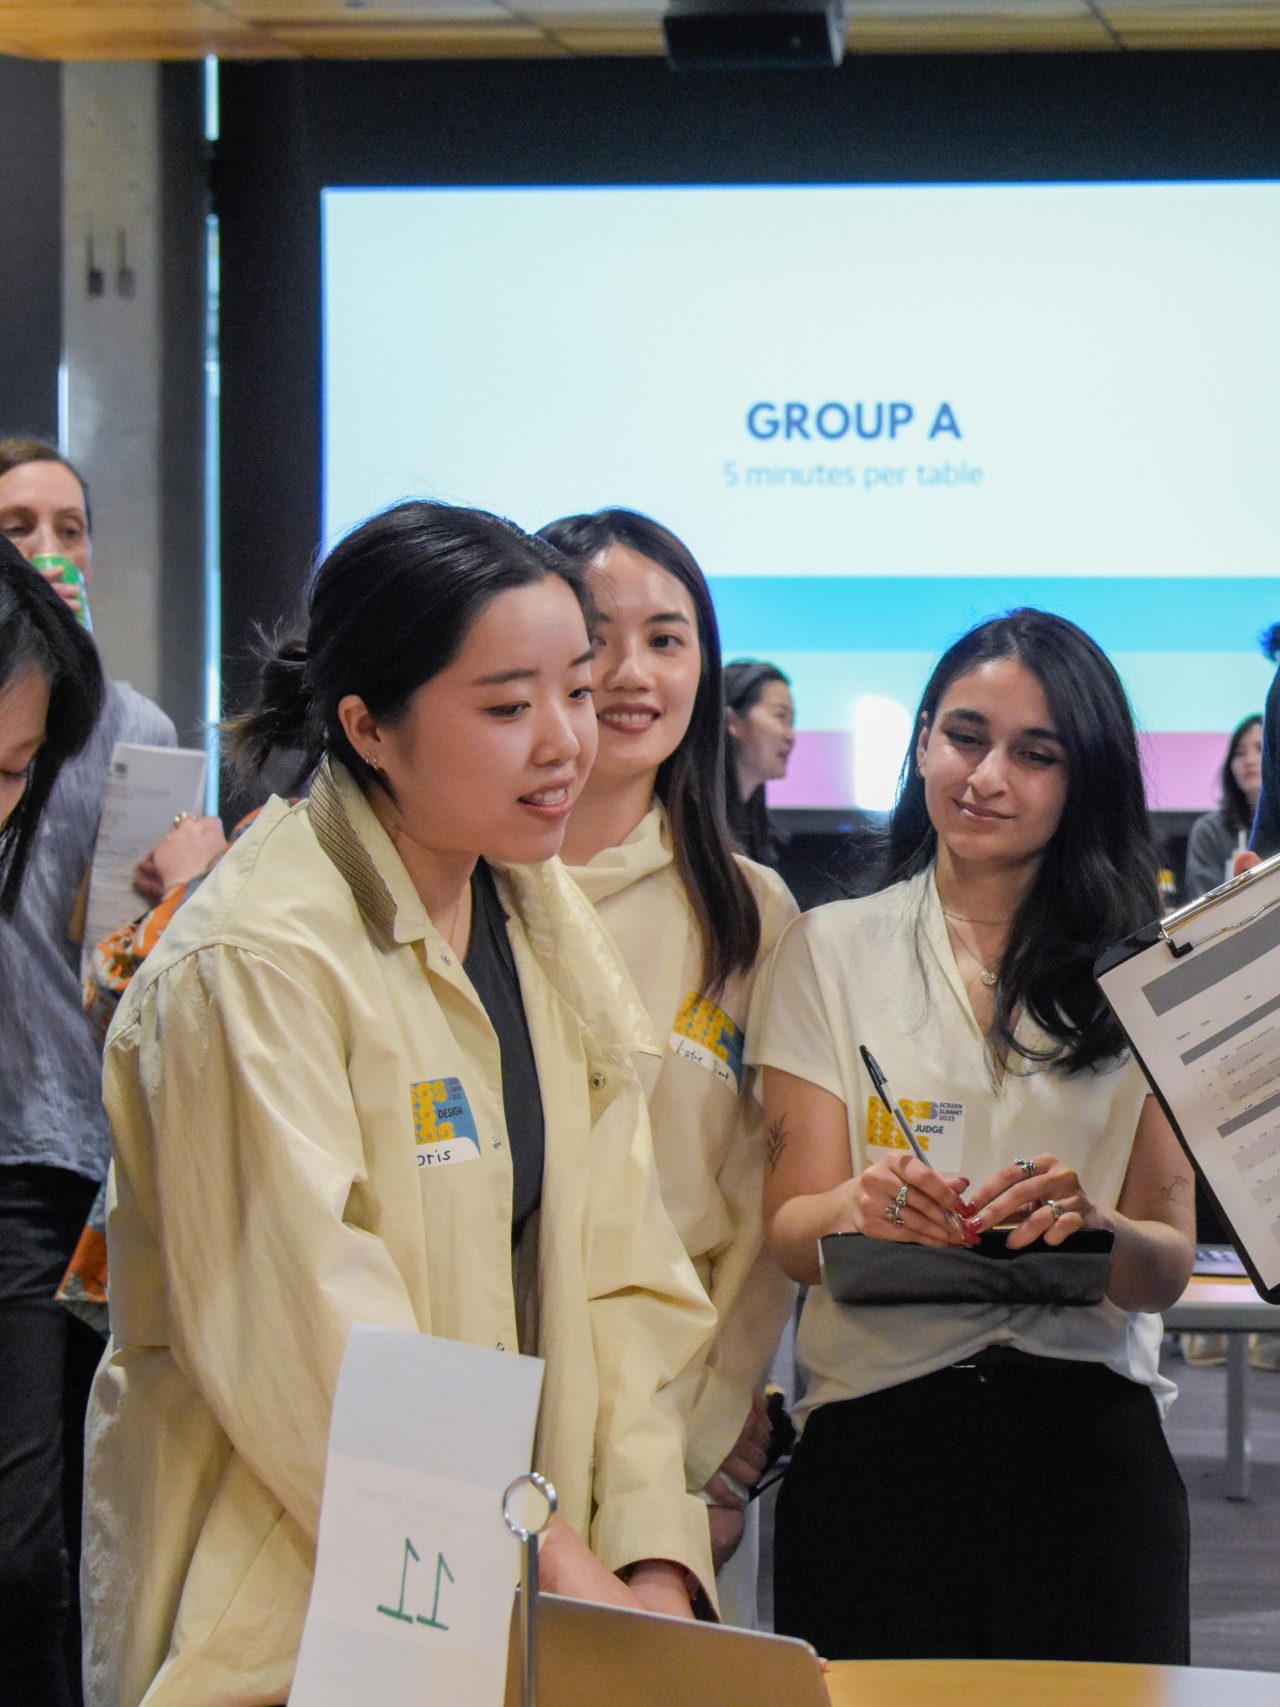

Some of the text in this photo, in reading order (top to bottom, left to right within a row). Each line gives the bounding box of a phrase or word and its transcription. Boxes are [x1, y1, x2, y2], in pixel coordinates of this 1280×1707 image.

[747, 402, 963, 440] GROUP A
[724, 460, 984, 492] 5 minutes per table
[438, 1106, 463, 1119] DESIGN
[915, 1125, 944, 1134] JUDGE
